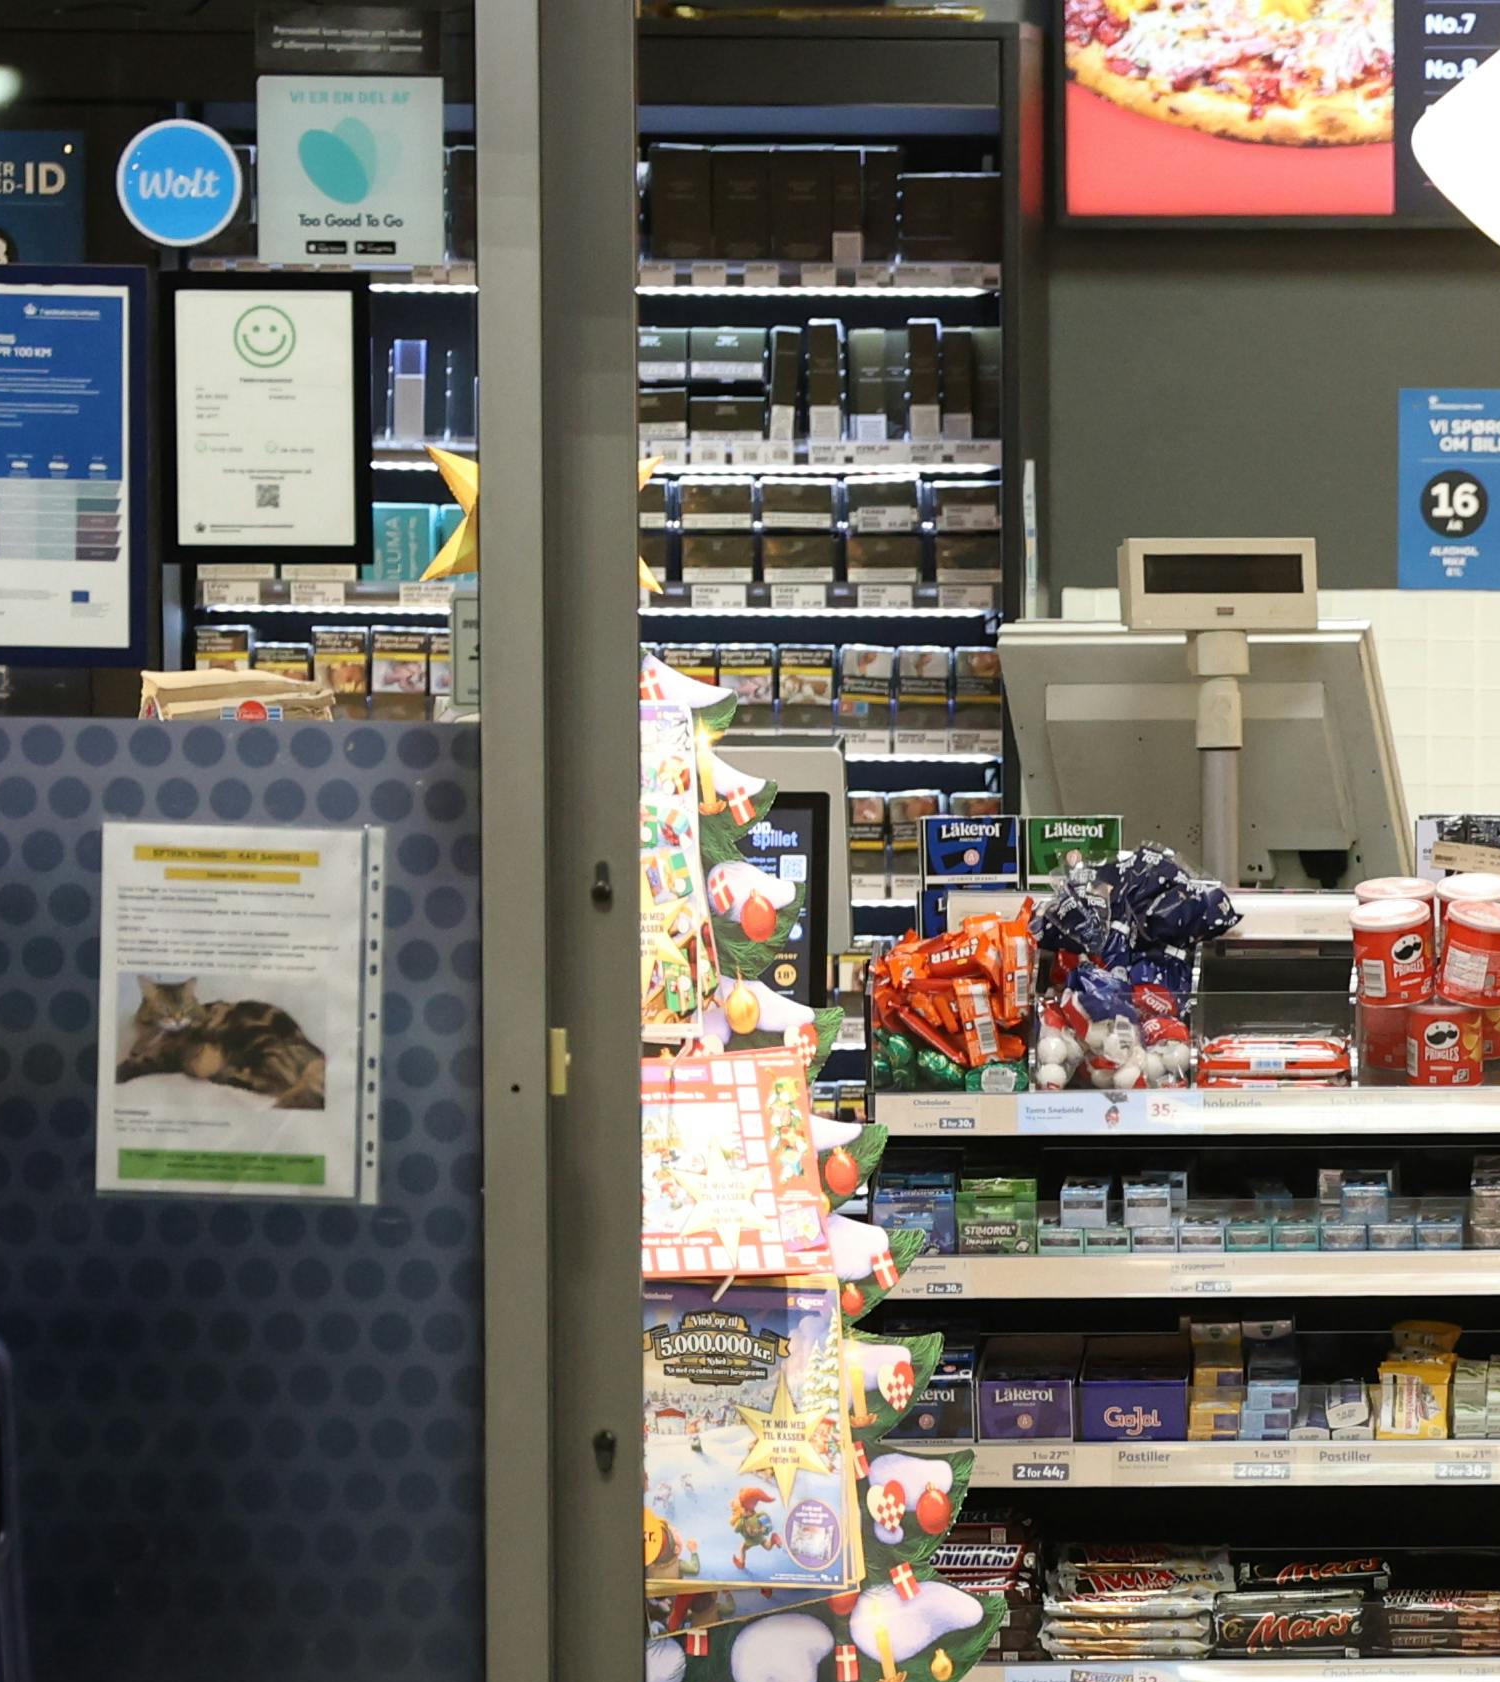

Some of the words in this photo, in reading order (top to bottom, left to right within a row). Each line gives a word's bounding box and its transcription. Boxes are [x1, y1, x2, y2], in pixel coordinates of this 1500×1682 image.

[1425, 13, 1476, 34] No.7
[25, 161, 67, 195] ID
[138, 168, 221, 200] Wolt
[298, 214, 321, 228] Too
[325, 213, 361, 228] Good
[366, 214, 379, 228] To
[384, 214, 404, 228] Go
[1429, 419, 1448, 435] VI
[1439, 437, 1468, 452] OM
[1430, 482, 1480, 518] 16
[942, 822, 1002, 840] Läkerol
[1045, 822, 1105, 840] Läkerol
[752, 830, 798, 850] spillet
[1393, 956, 1426, 978] PRINGLES
[1424, 1046, 1460, 1063] PRINGLES
[1202, 1097, 1263, 1110] hokolade
[964, 1225, 1012, 1237] STIMOROL
[691, 1314, 713, 1328] Vind
[714, 1318, 726, 1329] op
[660, 1333, 751, 1356] 5.000.000
[753, 1342, 773, 1361] kr.
[916, 1387, 955, 1403] kerol
[995, 1387, 1053, 1404] Läkerol
[1118, 1450, 1171, 1462] Pastiller
[1319, 1450, 1371, 1463] Pastiller
[1017, 1466, 1026, 1478] 2
[1028, 1465, 1041, 1478] for
[1237, 1464, 1247, 1476] 2
[1439, 1464, 1448, 1476] 2
[930, 1545, 1019, 1567] SNICKERS
[1277, 1556, 1382, 1584] Mars
[1247, 1611, 1354, 1653] Mars
